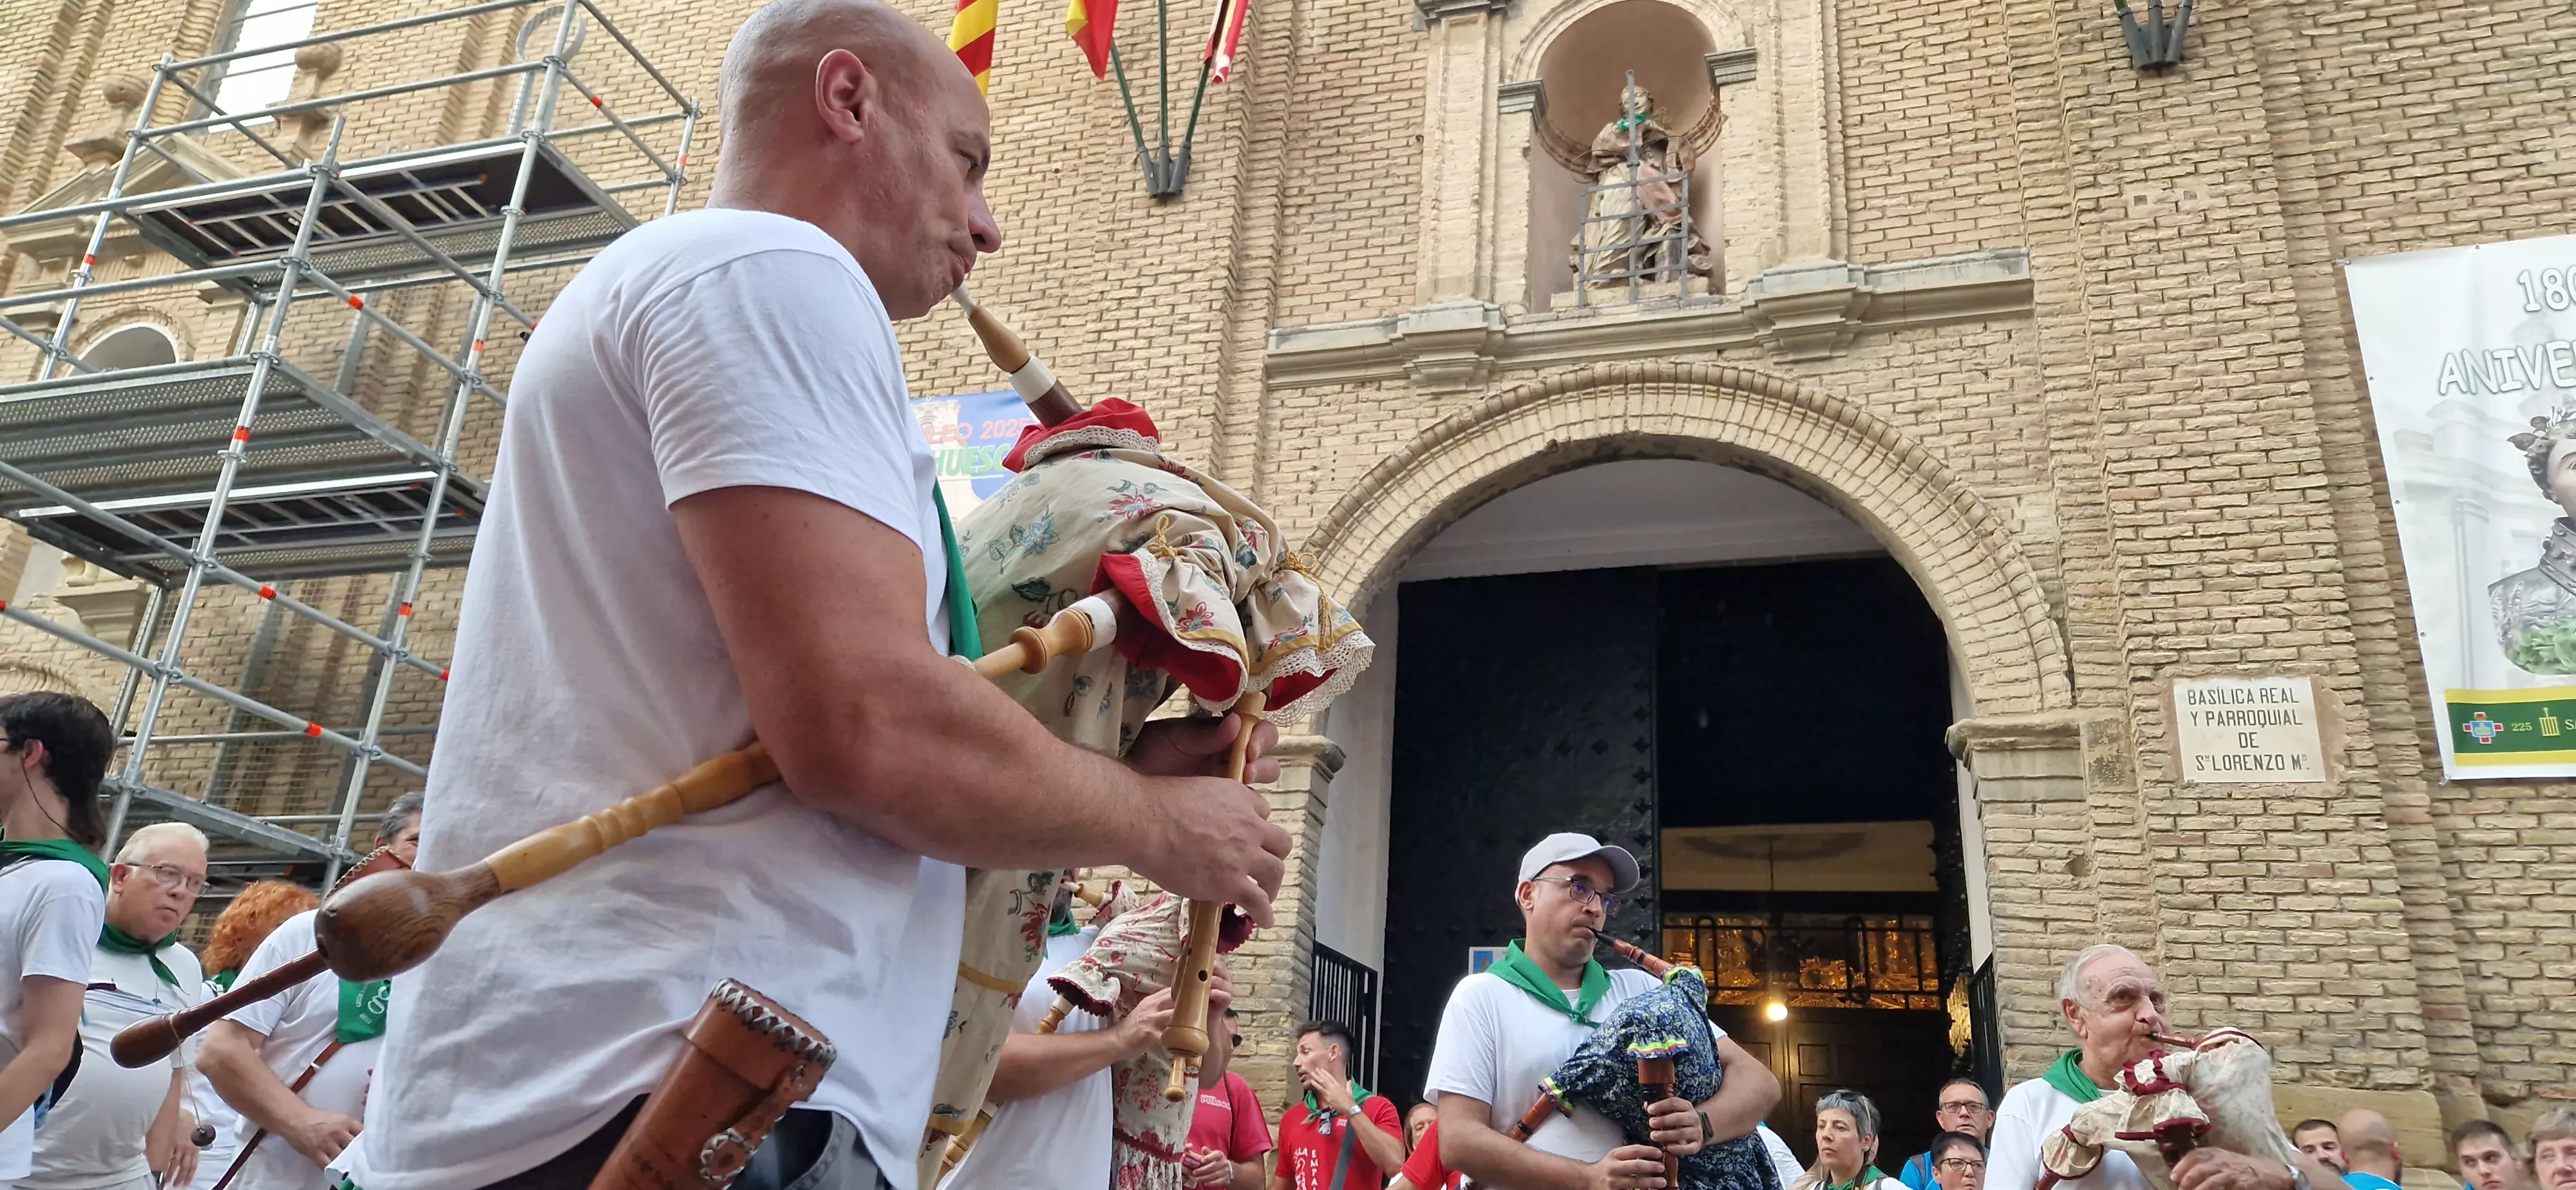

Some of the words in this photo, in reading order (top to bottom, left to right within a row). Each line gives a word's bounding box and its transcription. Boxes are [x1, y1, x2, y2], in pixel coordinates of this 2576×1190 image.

[2438, 339, 2576, 395] ANIVE
[2187, 686, 2255, 706] BASÍLICA
[2259, 687, 2300, 704] REAL
[2190, 710, 2199, 727] Y
[2205, 709, 2303, 728] PARROQUIAL
[2512, 722, 2533, 732] 225
[2565, 719, 2576, 730] S
[2238, 732, 2259, 748] DE
